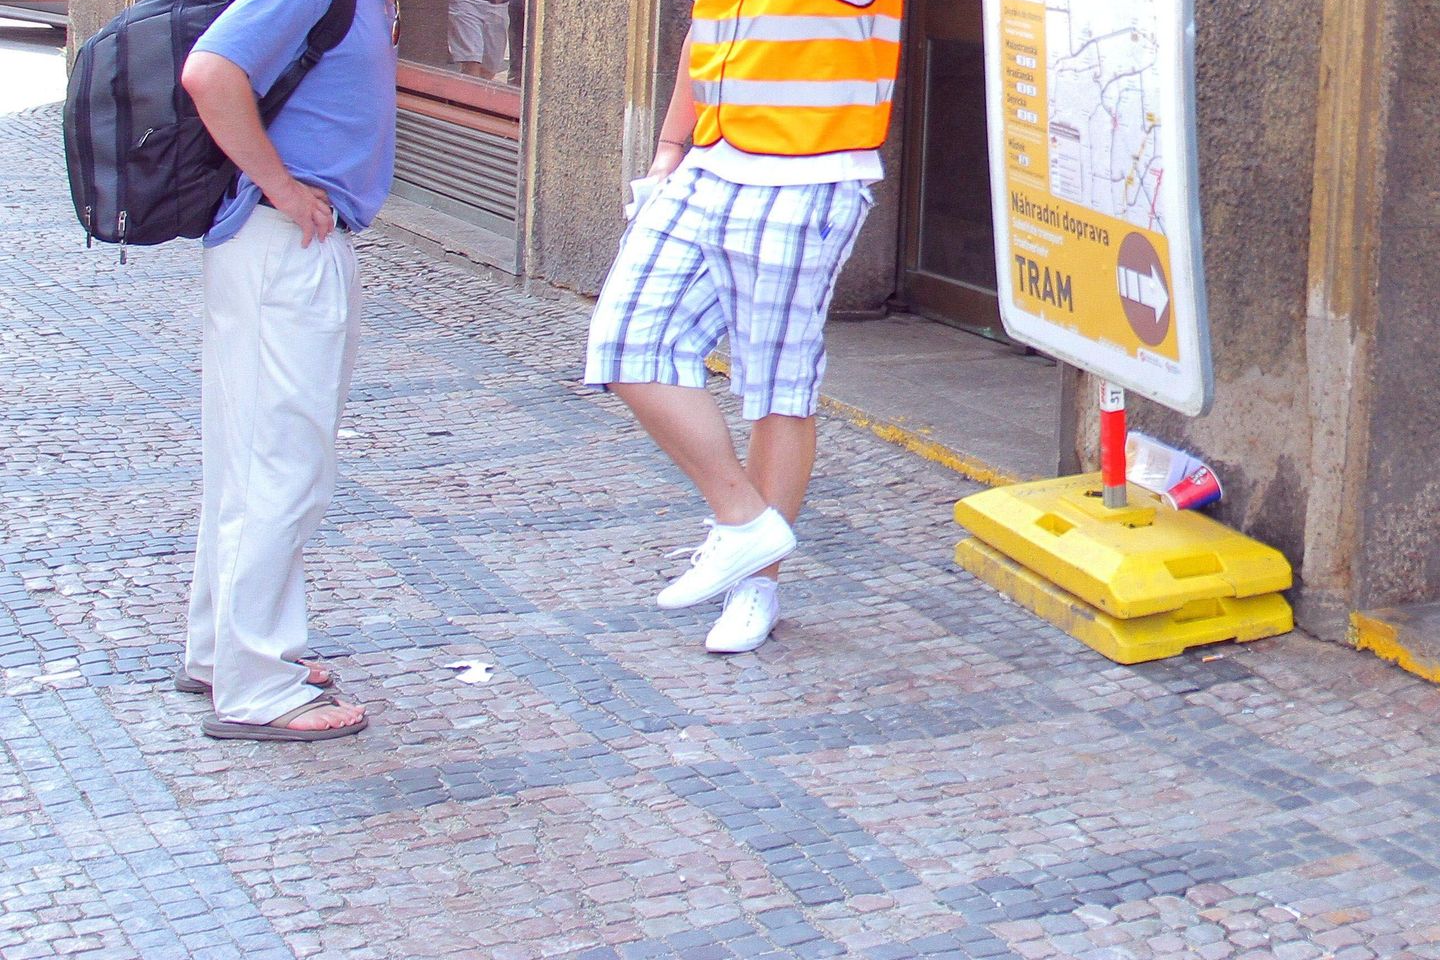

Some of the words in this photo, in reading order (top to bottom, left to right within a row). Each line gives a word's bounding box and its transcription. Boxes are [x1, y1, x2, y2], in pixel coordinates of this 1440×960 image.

[1011, 191, 1060, 229] Náhradní
[1063, 211, 1109, 247] doprava
[1015, 254, 1074, 314] TRAM
